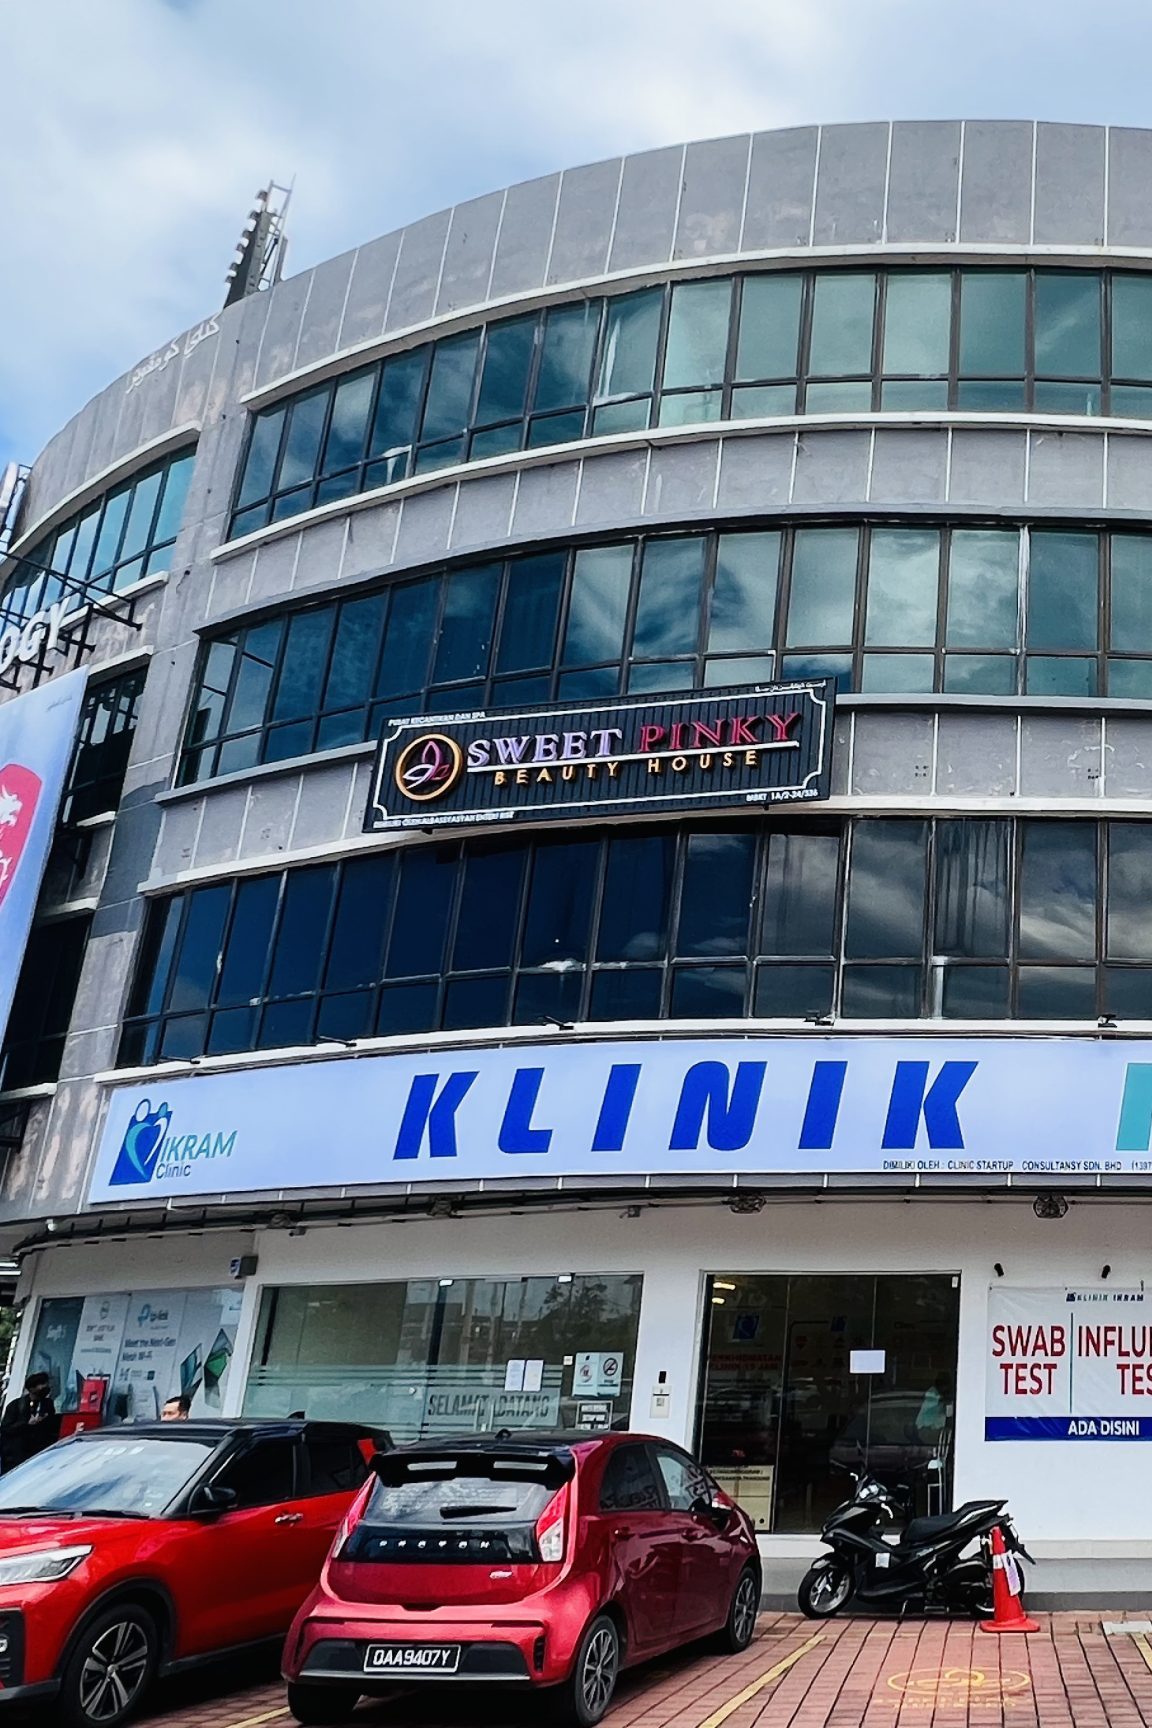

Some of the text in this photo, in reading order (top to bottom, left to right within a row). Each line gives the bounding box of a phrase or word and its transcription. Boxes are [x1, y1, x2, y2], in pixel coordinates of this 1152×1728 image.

[467, 711, 800, 767] SWEET PINKY
[494, 749, 759, 786] BEAUTY HOUSE
[392, 1060, 979, 1160] KLINIK
[161, 1130, 238, 1162] IKRAM
[156, 1163, 191, 1179] Clinic
[917, 1160, 940, 1170] OLEH
[948, 1160, 975, 1170] CLINIC
[976, 1160, 1014, 1170] STARTUP
[1022, 1160, 1082, 1171] CONSULTANSY
[1105, 1161, 1122, 1171] BHD
[992, 1325, 1065, 1357] SWAB
[1000, 1363, 1057, 1395] TEST
[1068, 1420, 1140, 1436] ADA DISINI
